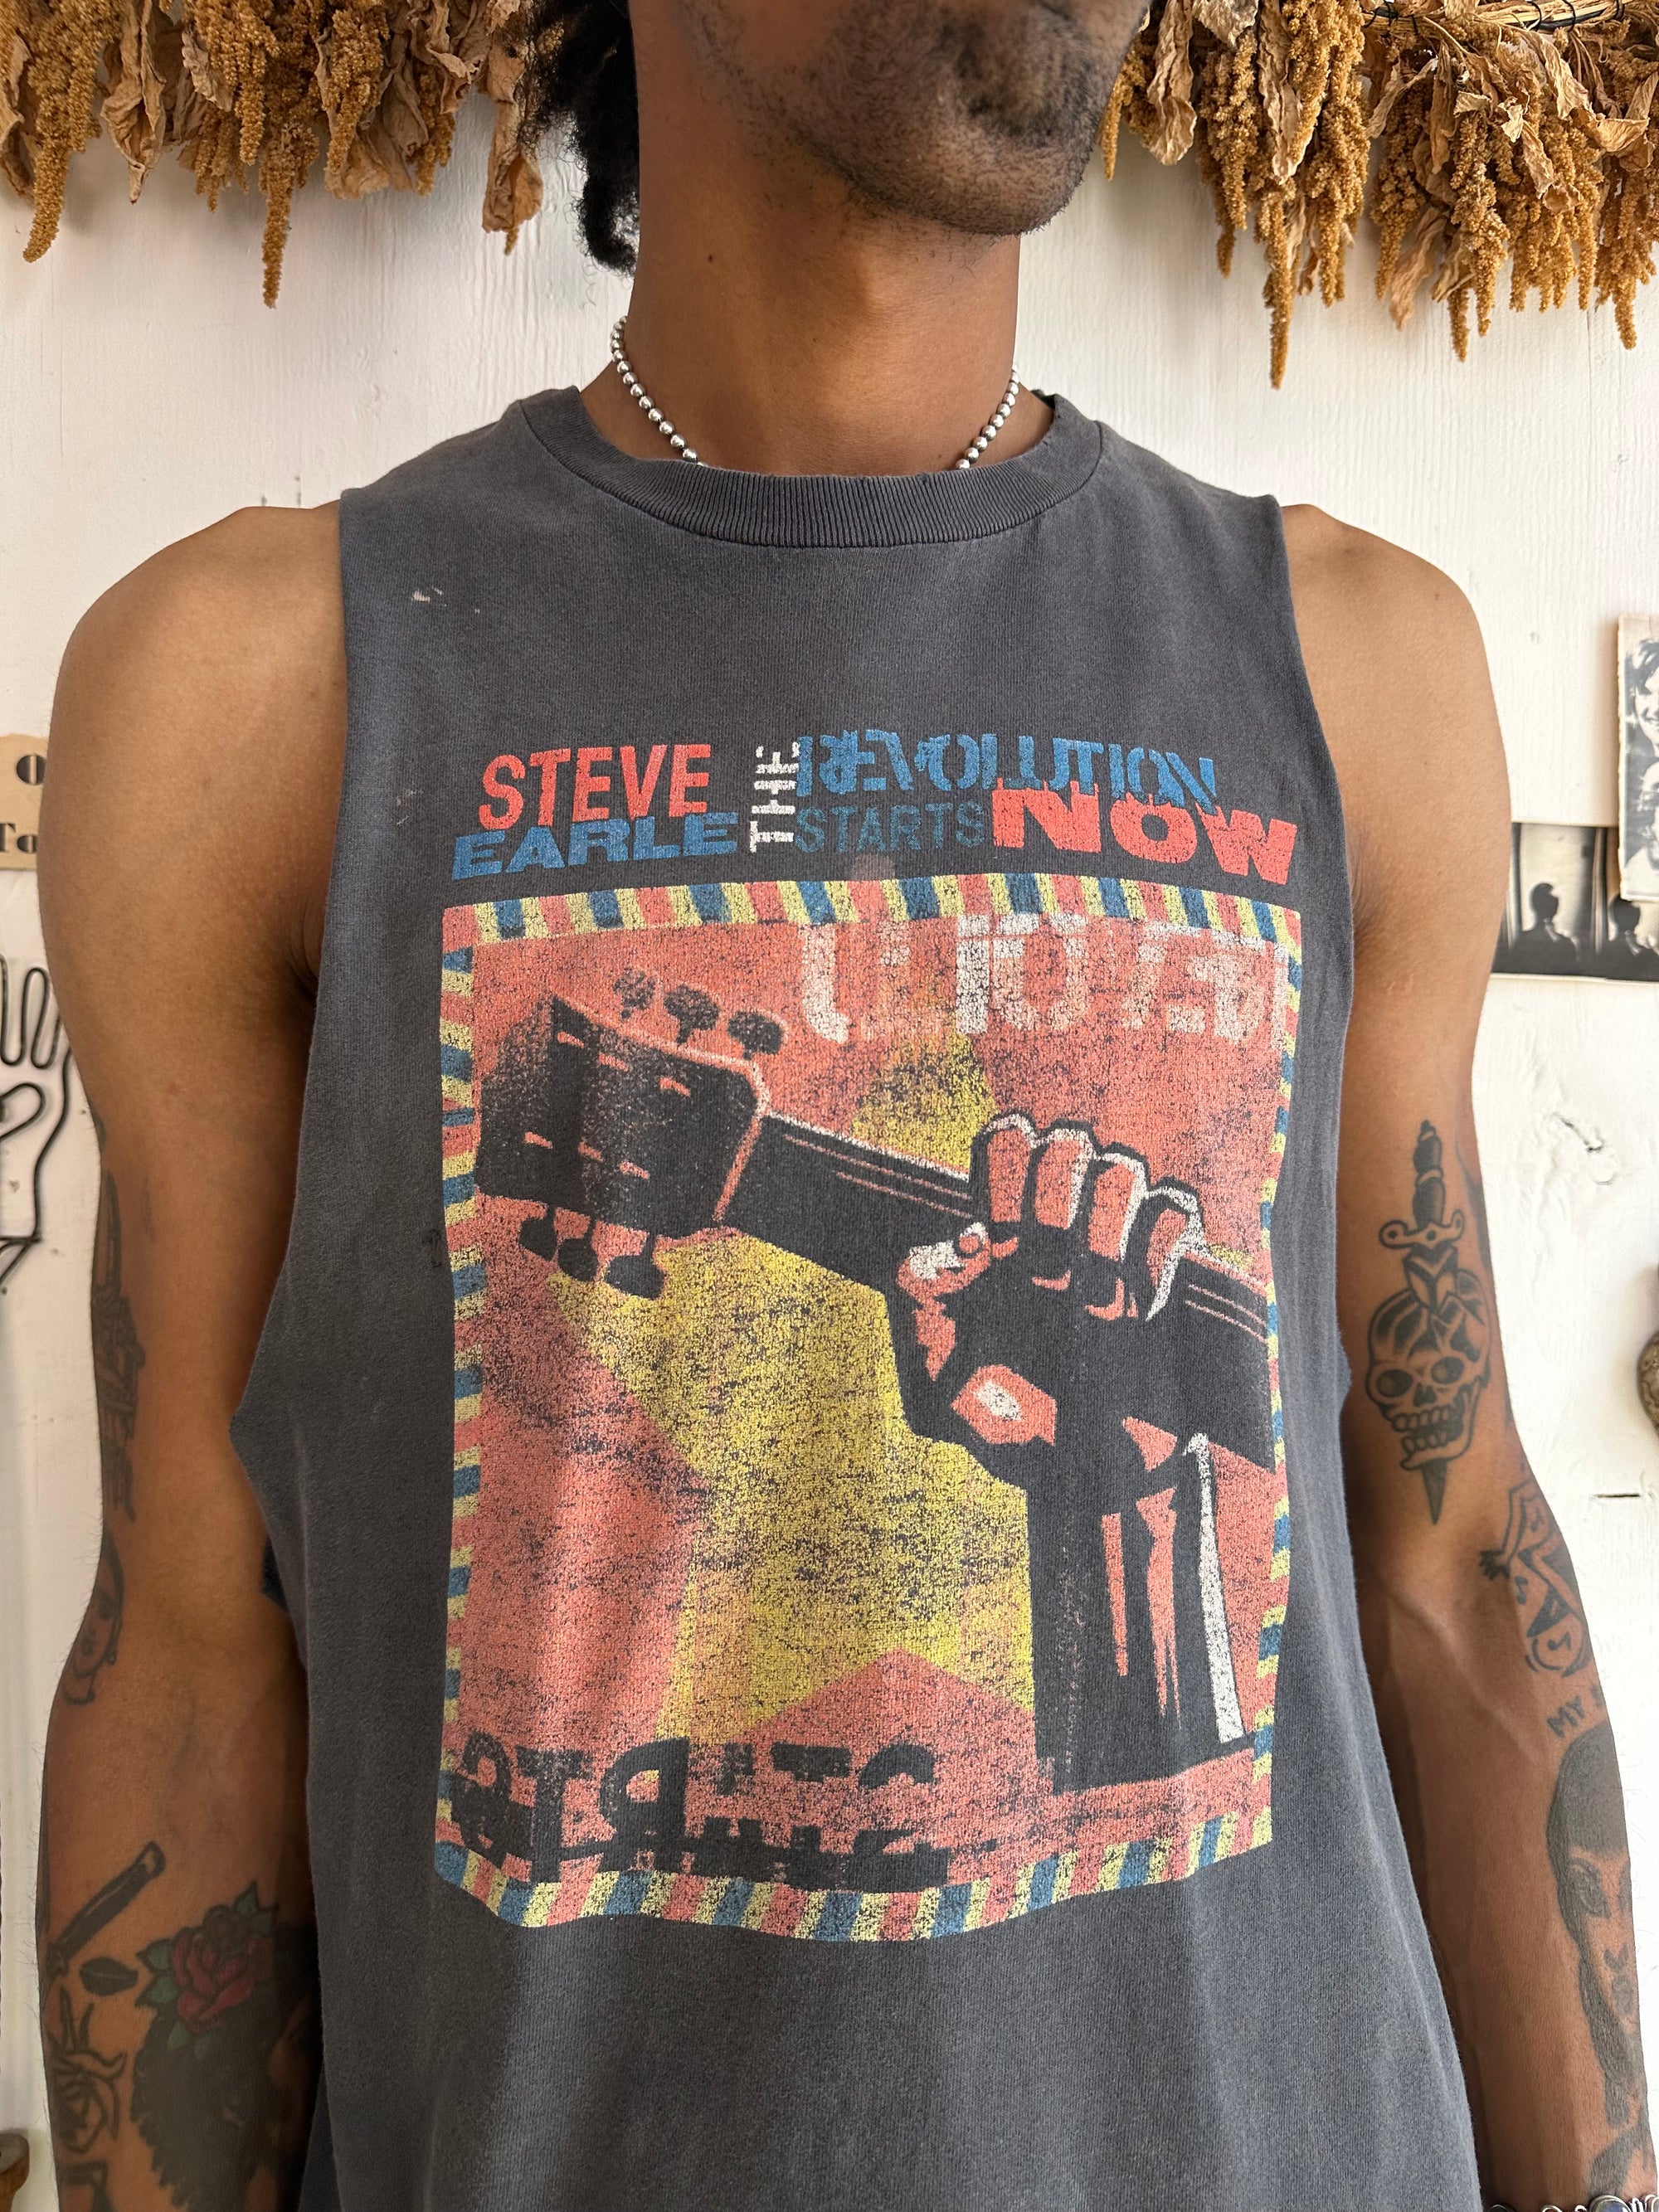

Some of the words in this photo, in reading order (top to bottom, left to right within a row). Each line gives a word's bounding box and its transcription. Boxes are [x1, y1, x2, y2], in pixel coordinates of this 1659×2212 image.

[478, 743, 712, 830] STEVE
[749, 741, 800, 853] THE
[796, 728, 1217, 816] REVOLUTION
[451, 812, 738, 880] EARLE
[795, 800, 985, 853] STARTS
[991, 778, 1298, 886] NOW
[1547, 1695, 1585, 1738] MY
